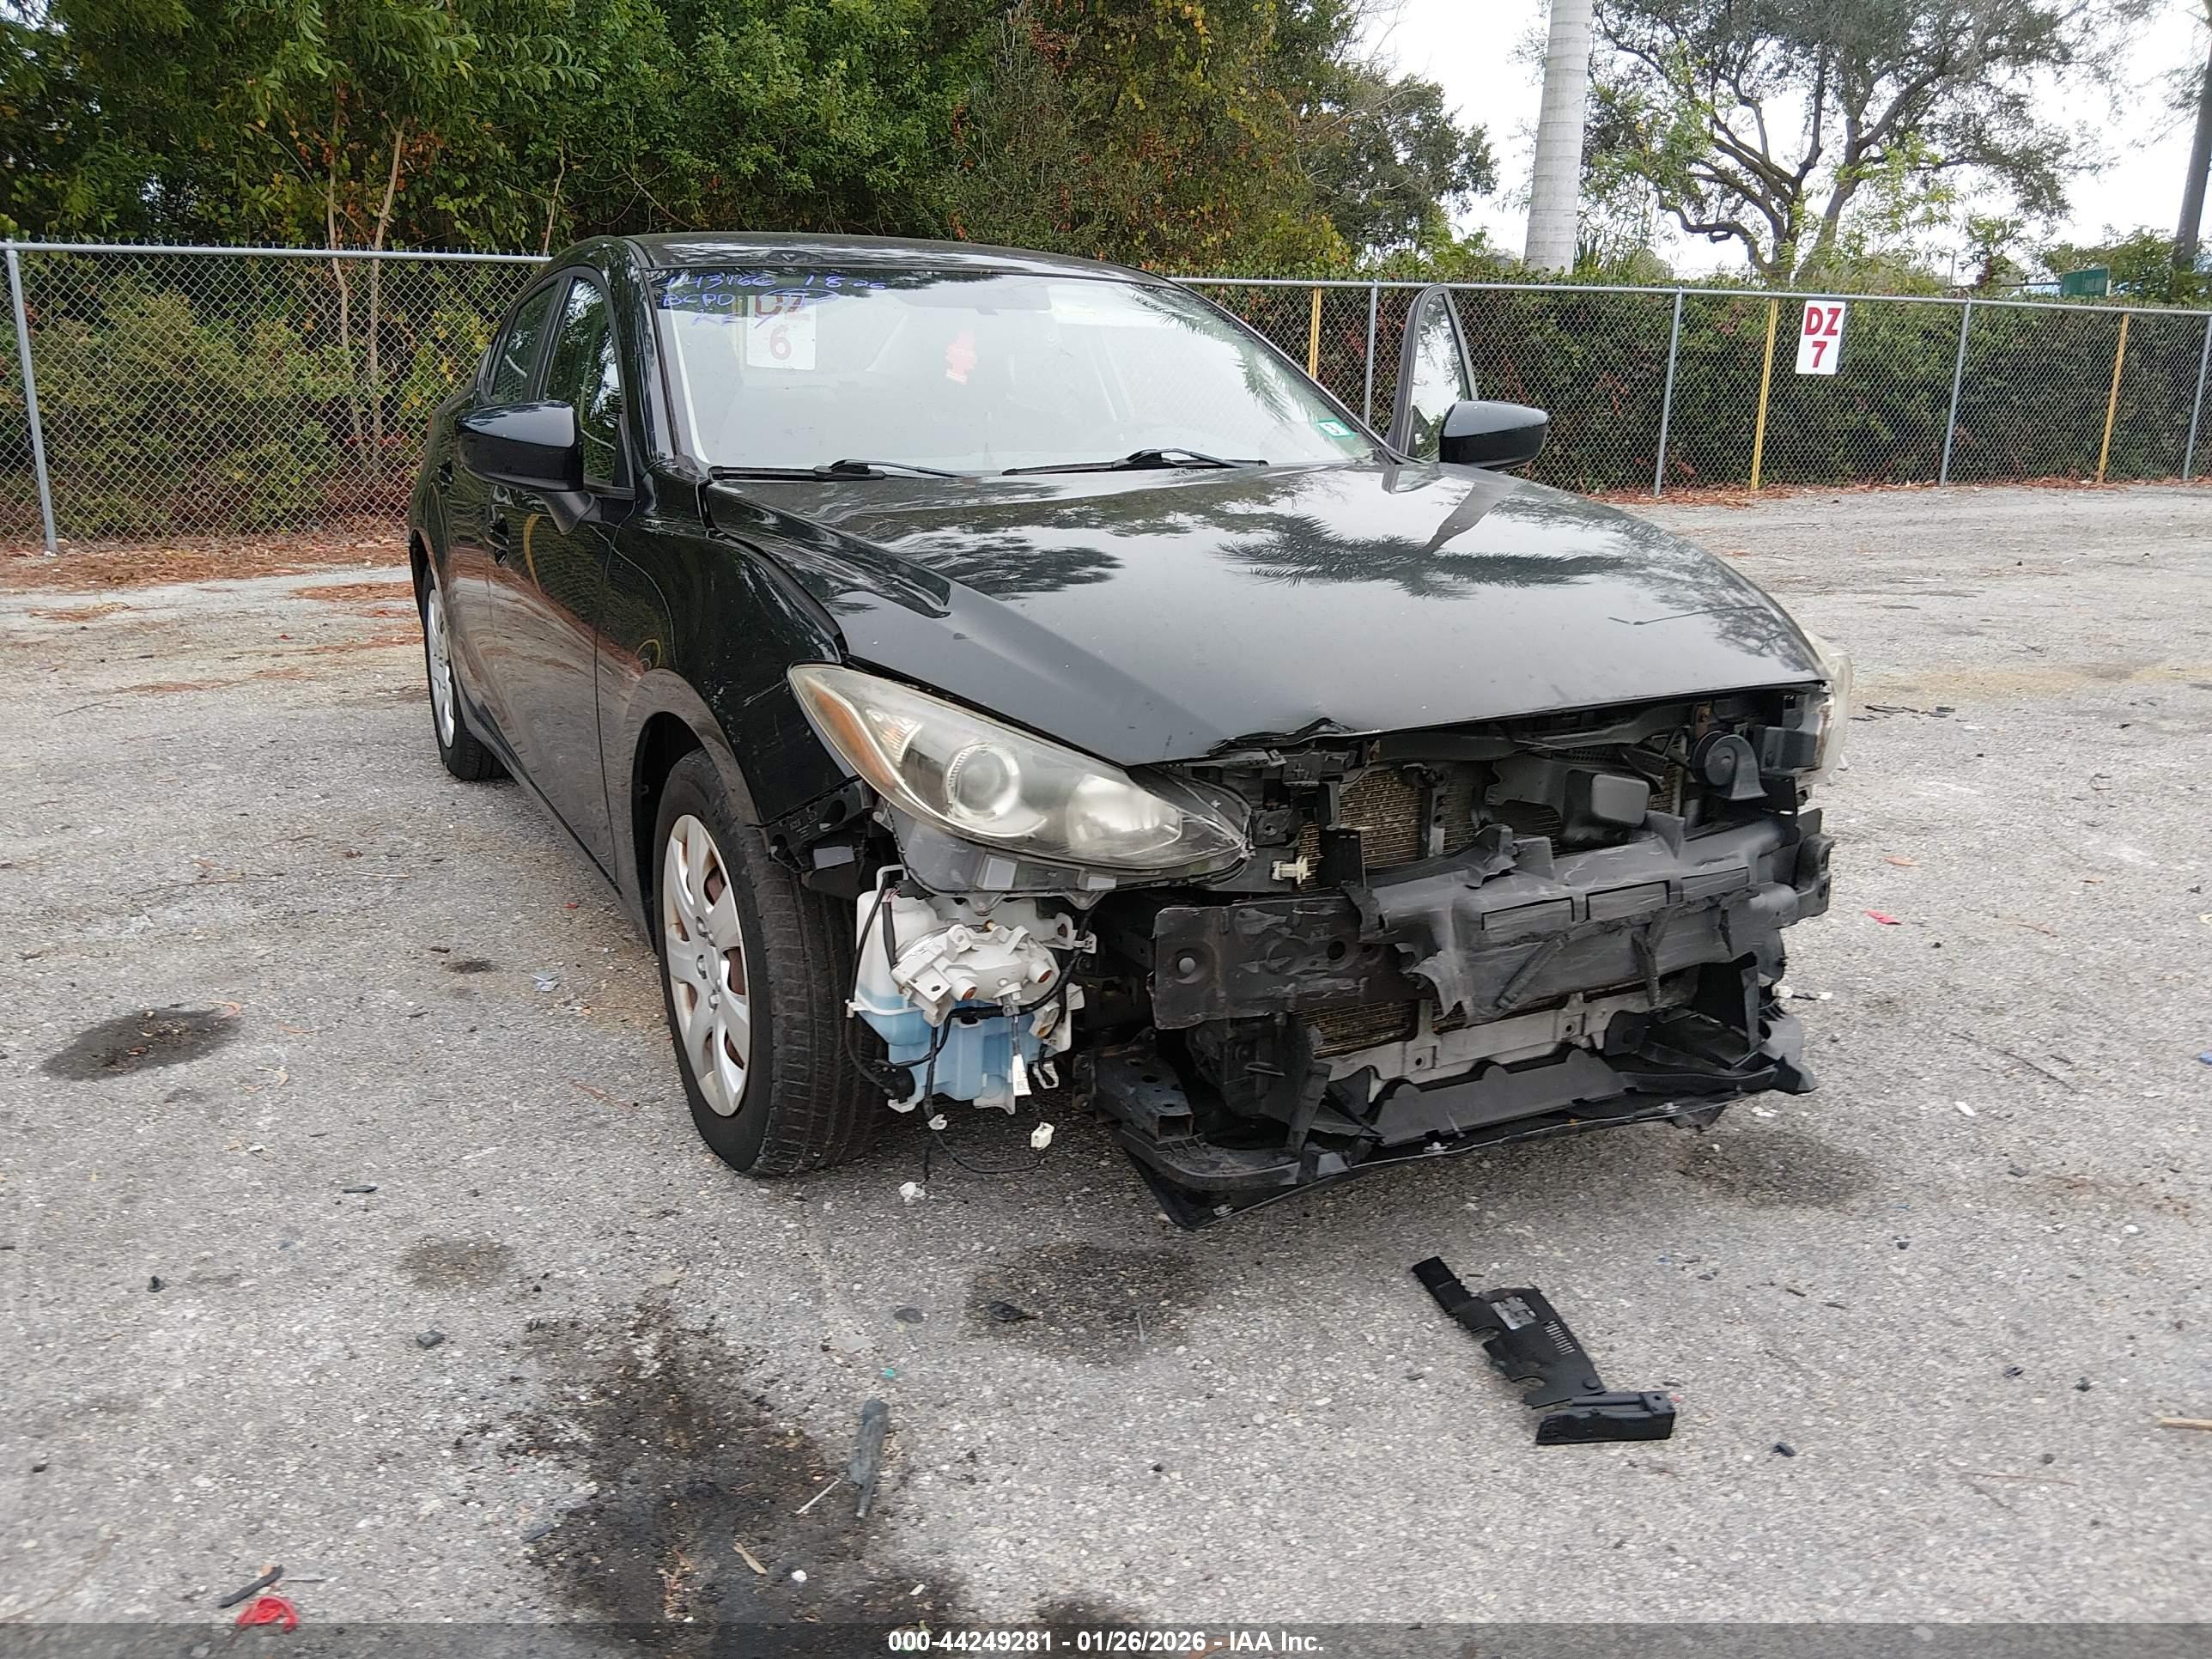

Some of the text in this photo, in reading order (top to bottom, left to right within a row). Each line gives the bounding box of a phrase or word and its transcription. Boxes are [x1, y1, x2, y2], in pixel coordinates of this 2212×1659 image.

[1804, 307, 1843, 337] DZ
[769, 323, 793, 361] 6
[1812, 340, 1828, 368] 7
